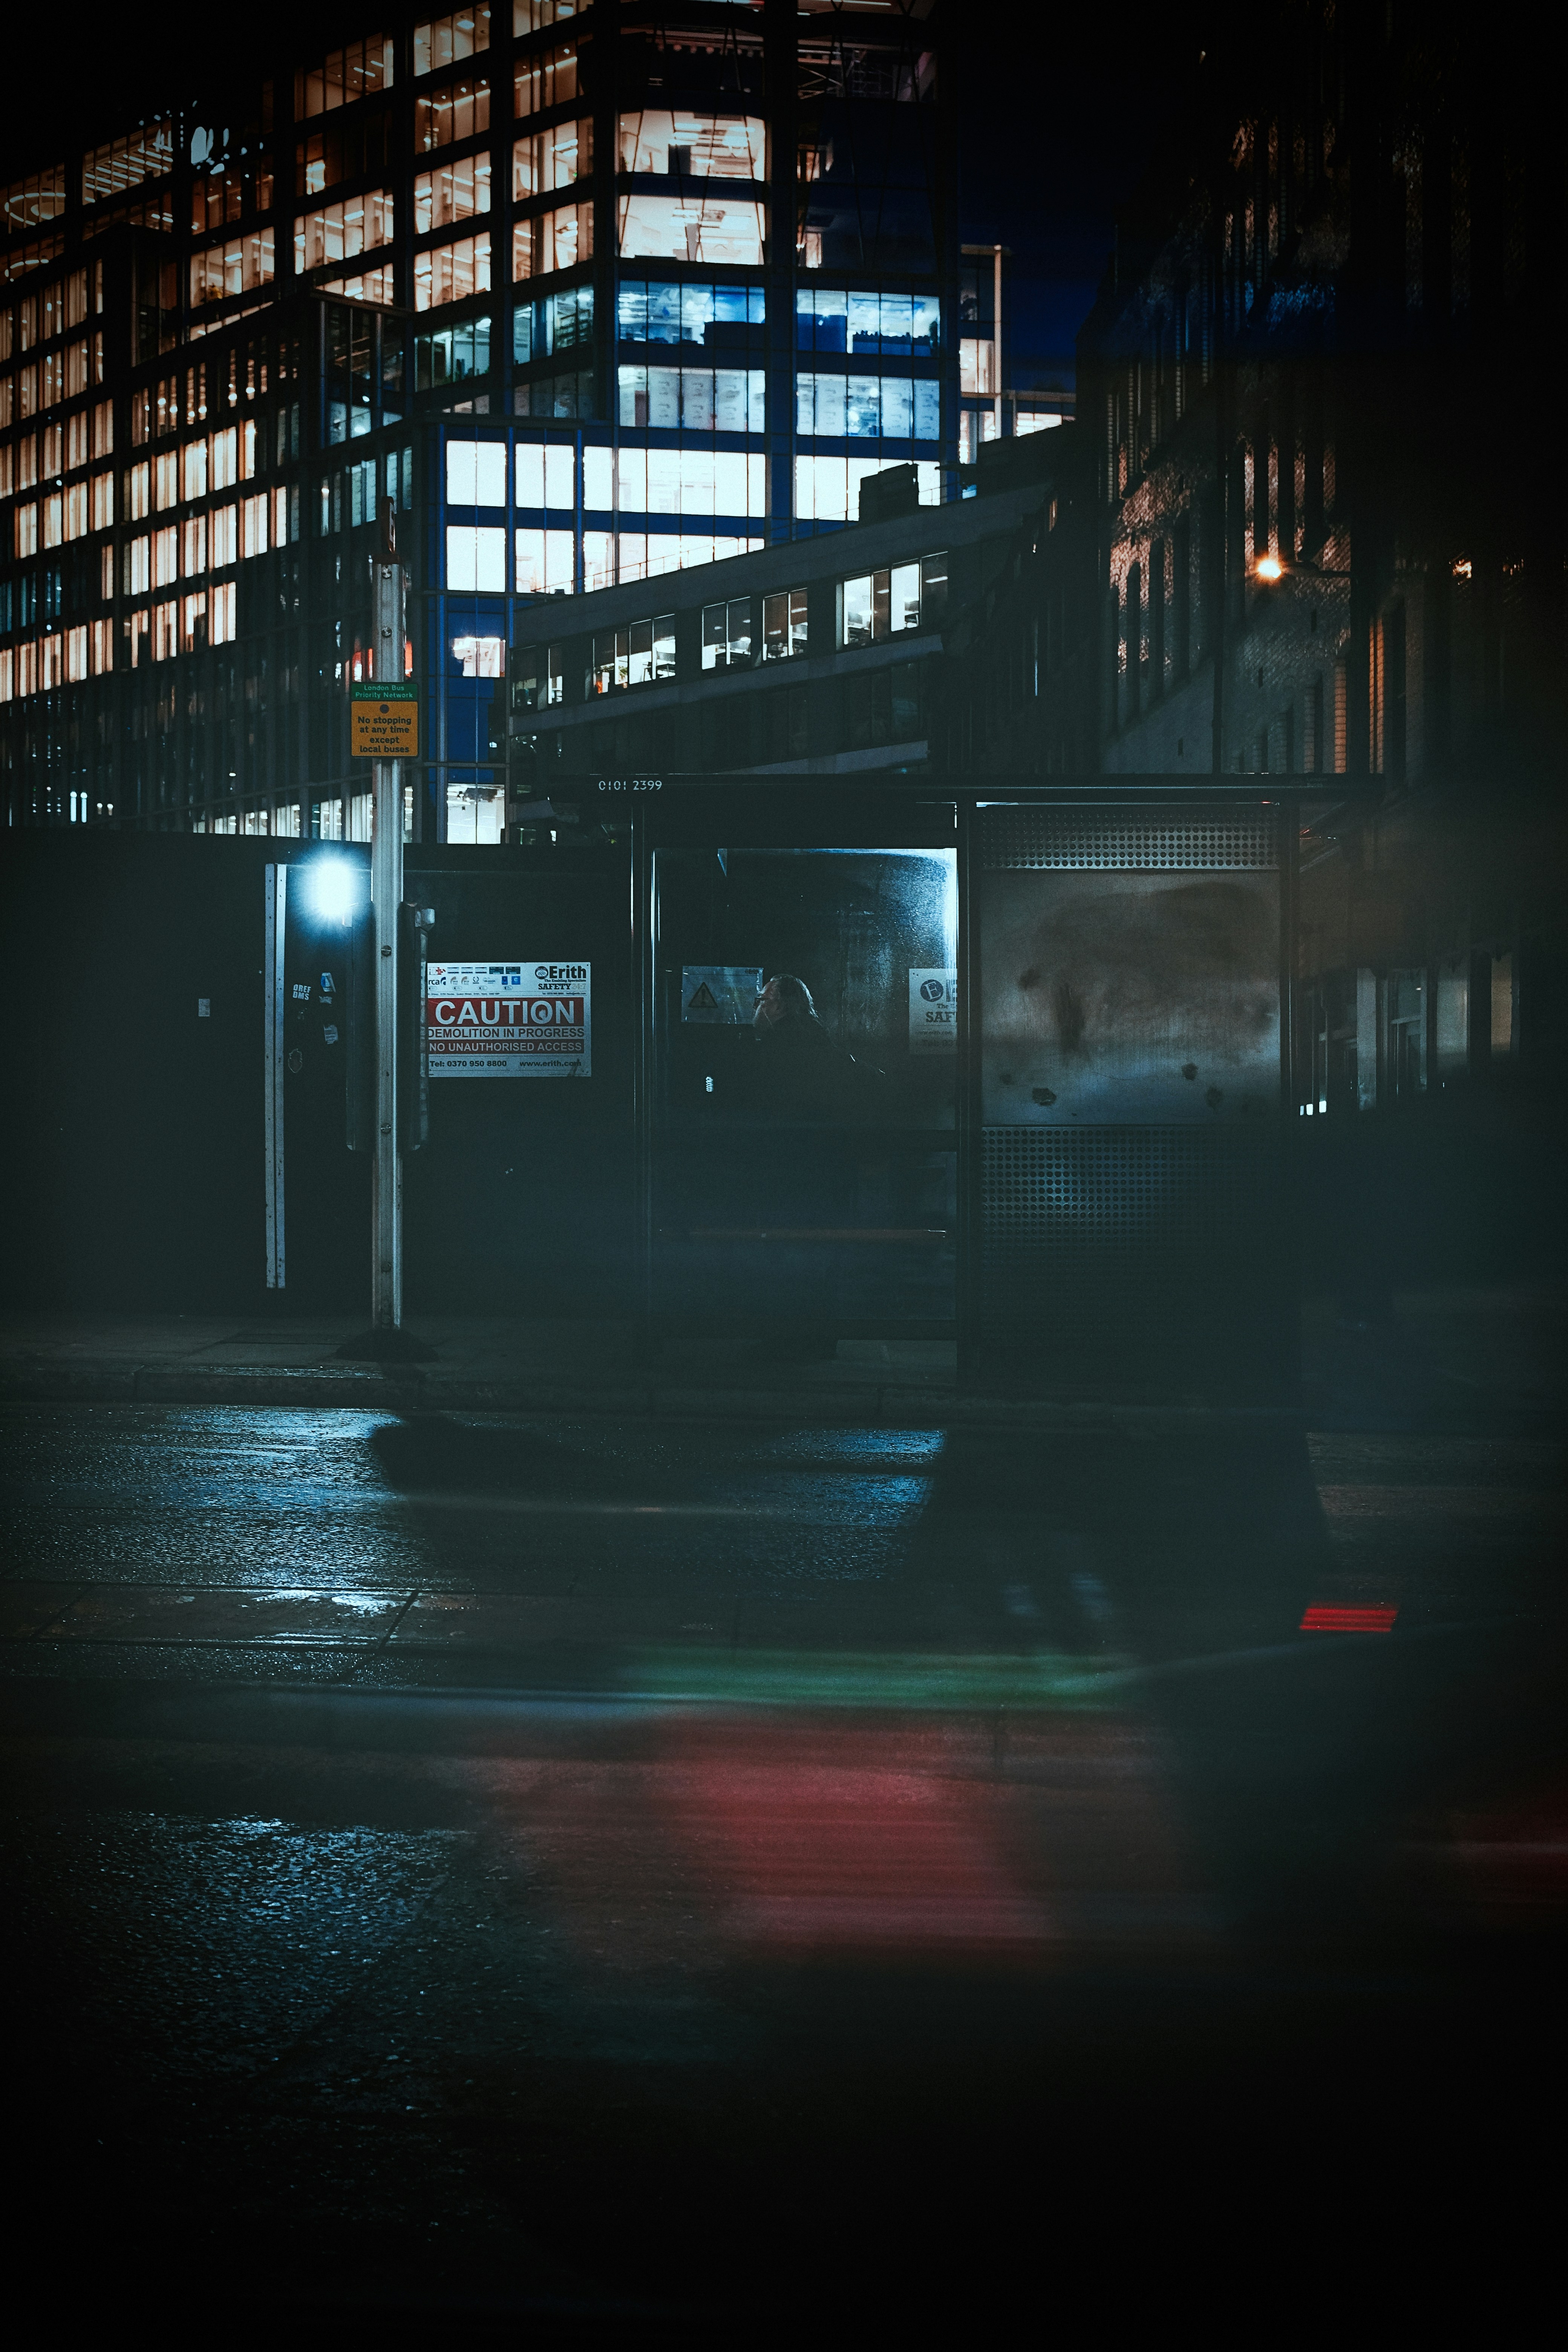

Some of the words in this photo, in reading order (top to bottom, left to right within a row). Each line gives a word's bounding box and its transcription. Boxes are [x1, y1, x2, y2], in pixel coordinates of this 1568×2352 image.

[373, 717, 412, 725] stopping
[632, 780, 662, 790] 2399
[549, 965, 586, 979] Erith
[435, 1000, 574, 1024] CAUTION
[429, 1029, 499, 1037] DEMOLITION
[504, 1029, 514, 1037] IN
[519, 1028, 584, 1037] PROGRESS
[430, 1043, 445, 1051] NO
[449, 1043, 534, 1051] UNAUTHORISED
[537, 1043, 582, 1051] ACCESS
